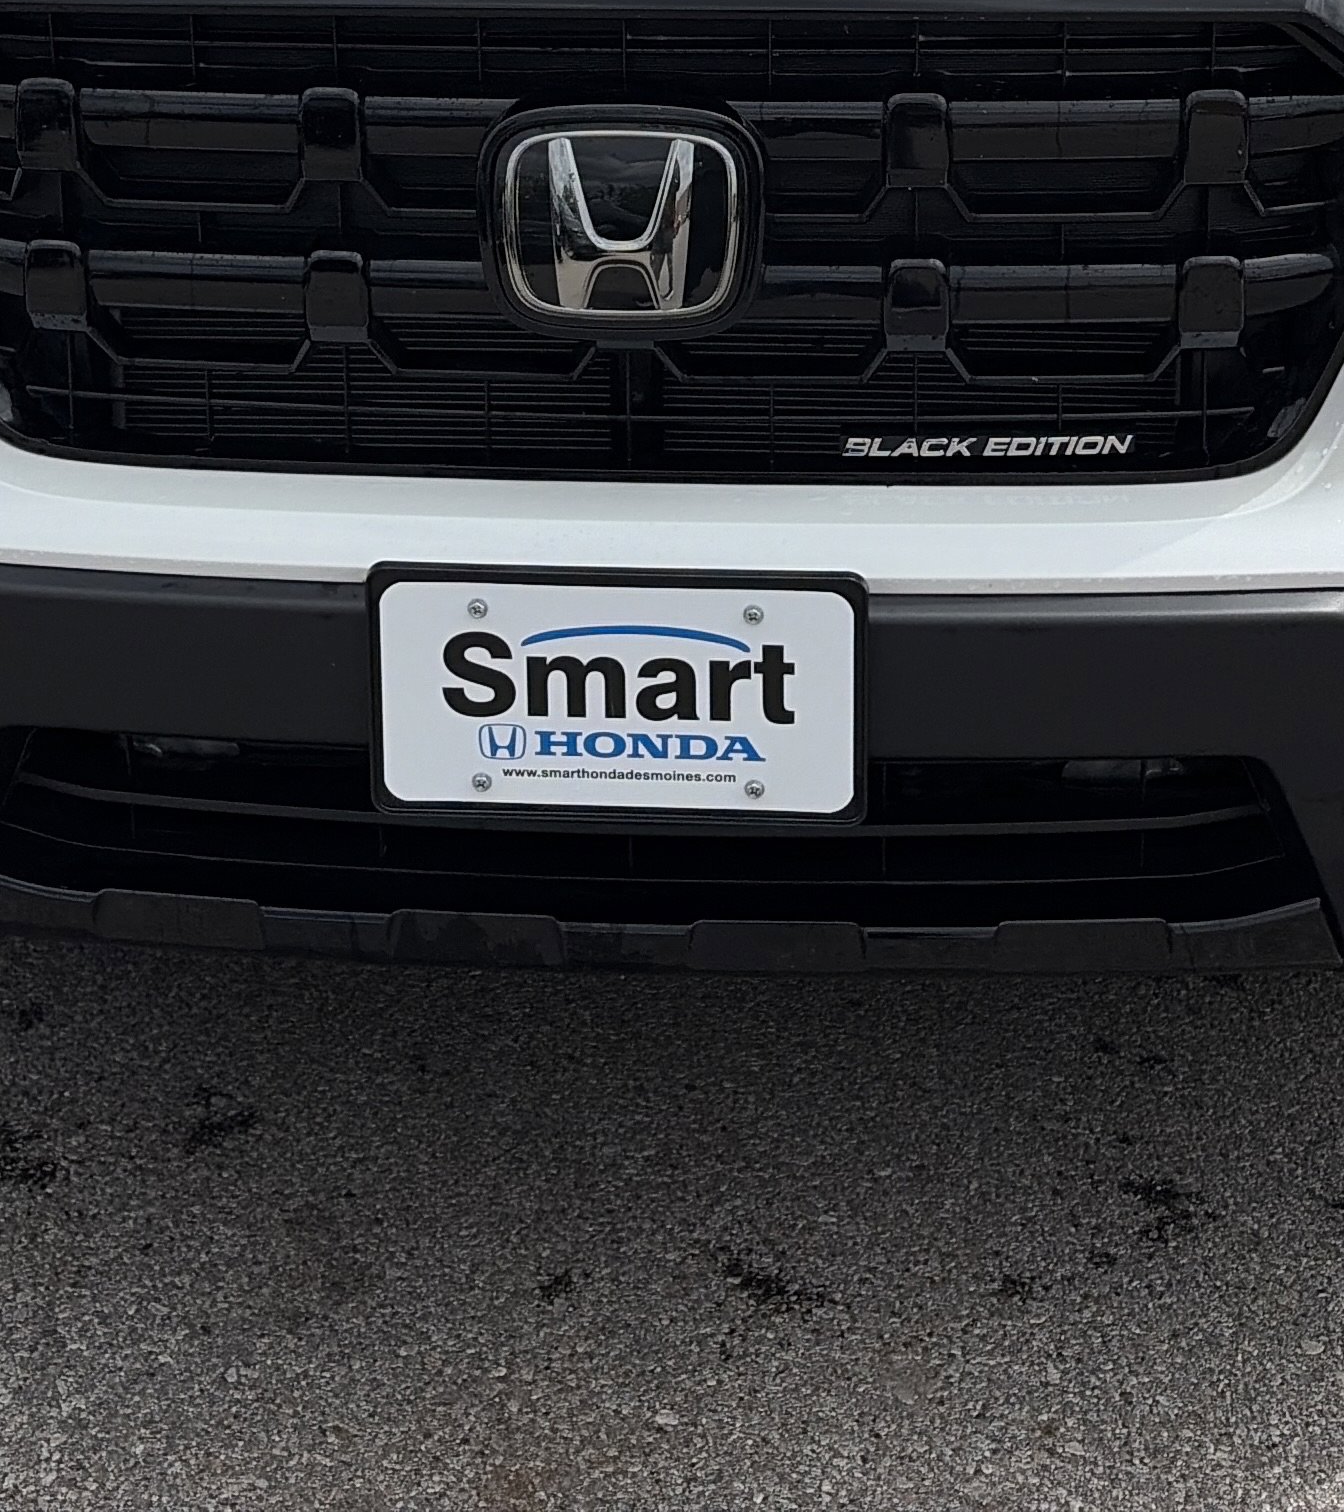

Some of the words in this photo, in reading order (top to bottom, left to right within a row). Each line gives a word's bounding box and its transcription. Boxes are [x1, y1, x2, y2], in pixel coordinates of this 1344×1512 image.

[842, 436, 978, 457] BLACK
[982, 434, 1134, 457] EDITION
[441, 630, 796, 725] Smart
[534, 729, 767, 763] HONDA
[501, 765, 737, 785] www.smarthondadesmoines.com
